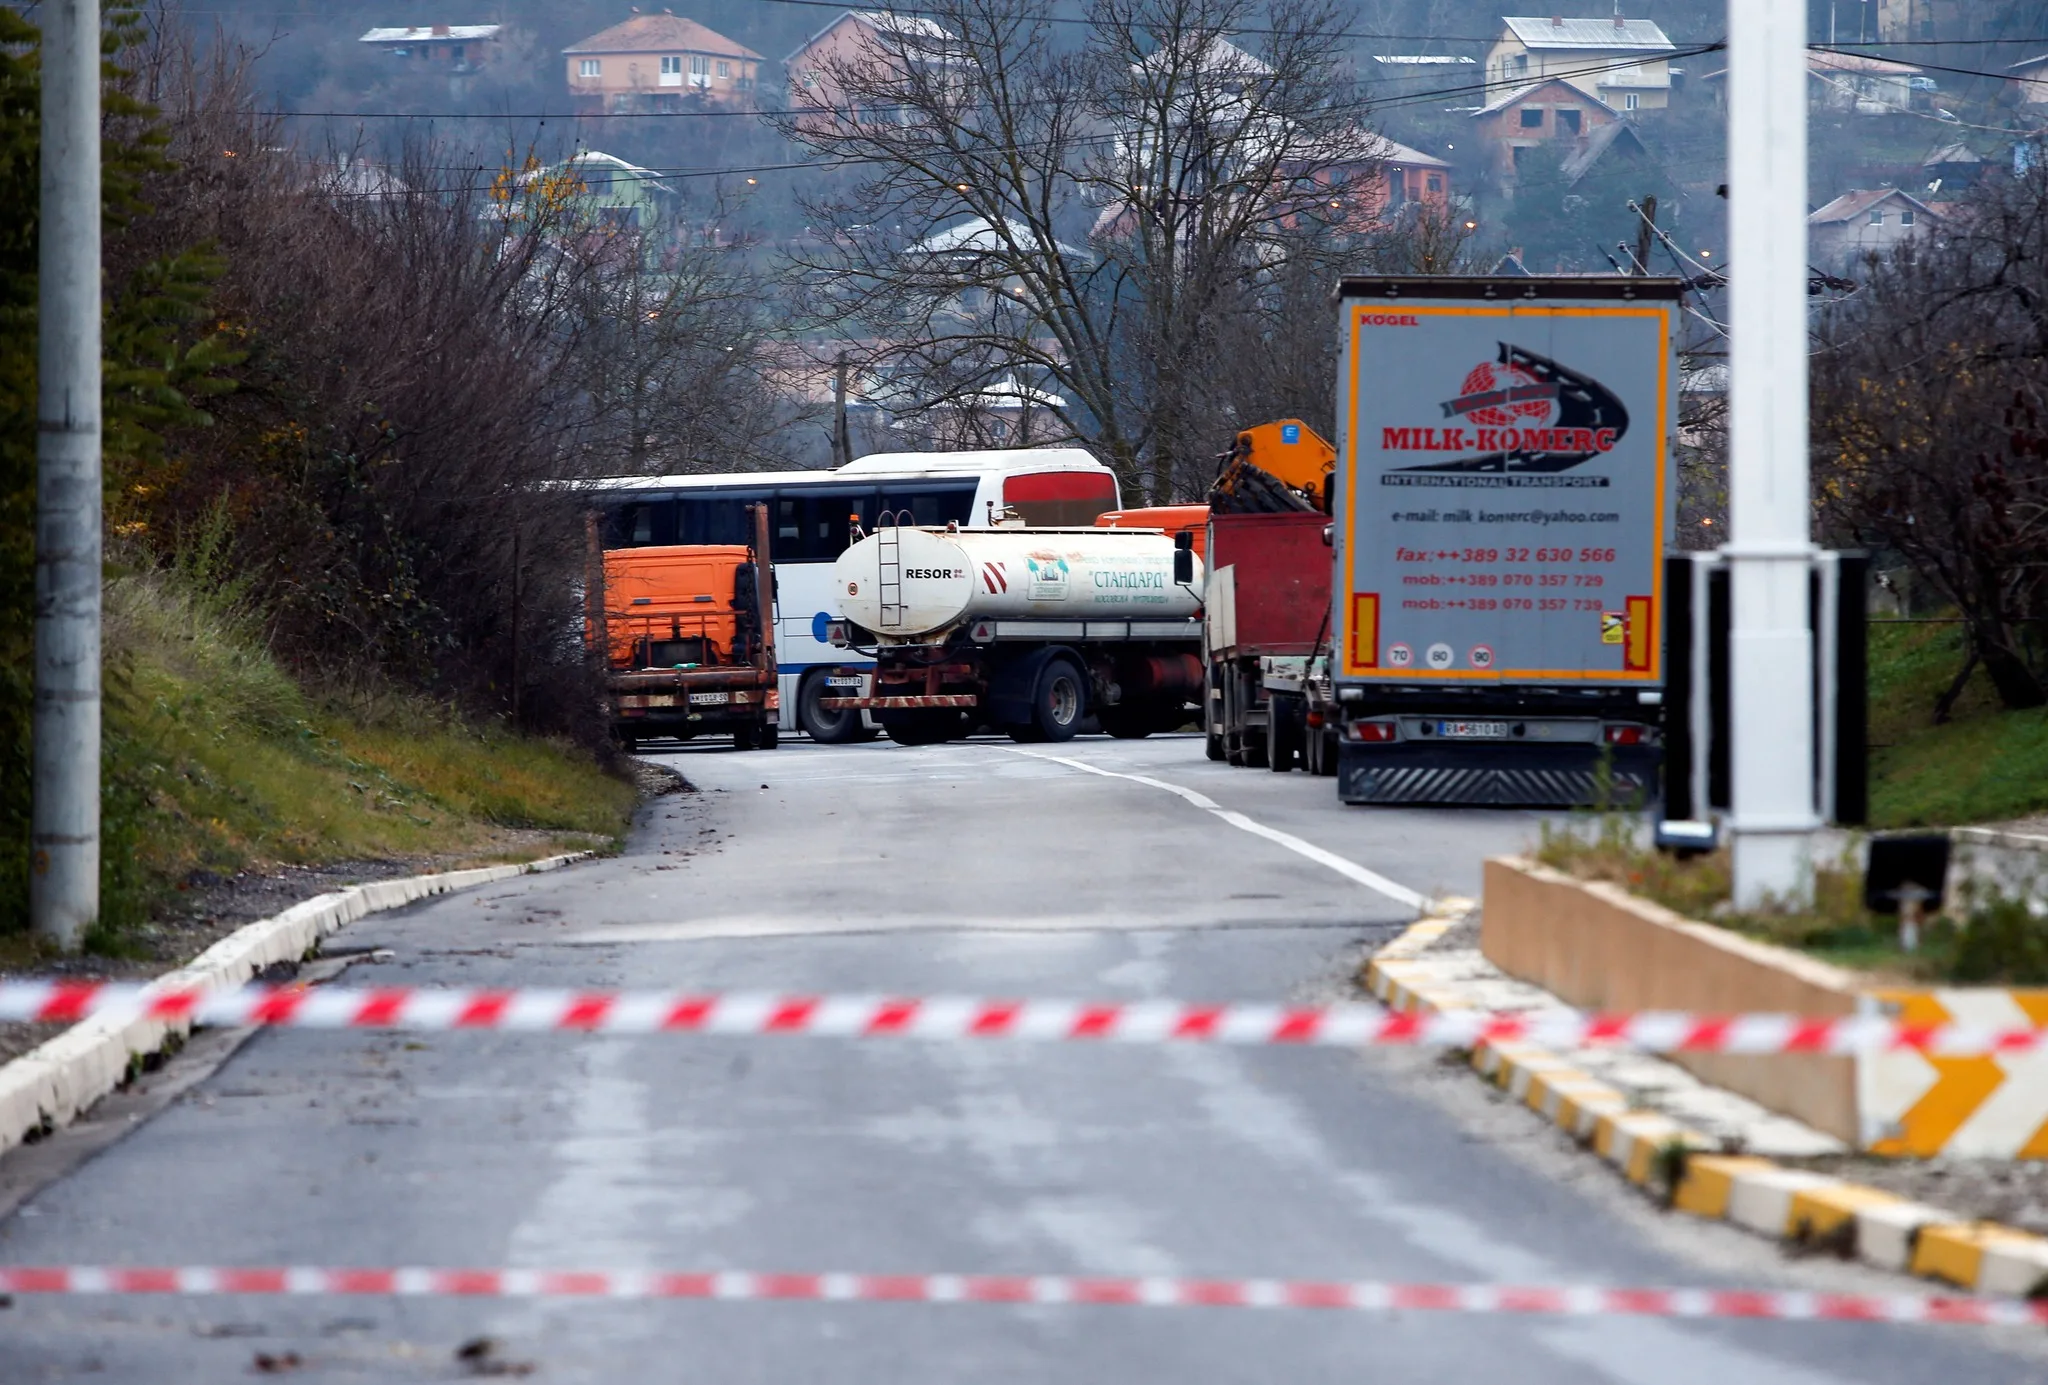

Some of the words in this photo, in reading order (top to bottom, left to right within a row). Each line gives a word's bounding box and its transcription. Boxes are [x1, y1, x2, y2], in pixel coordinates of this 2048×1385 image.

[1382, 428, 1615, 451] MILK-KOMERC
[1510, 476, 1601, 487] TRANSPORT
[1392, 511, 1439, 522] e-mail:
[1505, 548, 1529, 561] 32
[1536, 548, 1572, 562] 630
[1579, 548, 1615, 562] 566
[906, 568, 952, 579] RESOR
[1503, 574, 1533, 586] 070
[1539, 574, 1567, 586] 357
[1575, 575, 1603, 587] 729
[1503, 598, 1532, 610] 070
[1539, 599, 1567, 610] 357
[1574, 599, 1602, 611] 739
[1393, 650, 1408, 661] 70
[1433, 651, 1447, 662] 80
[1474, 651, 1490, 663] 90
